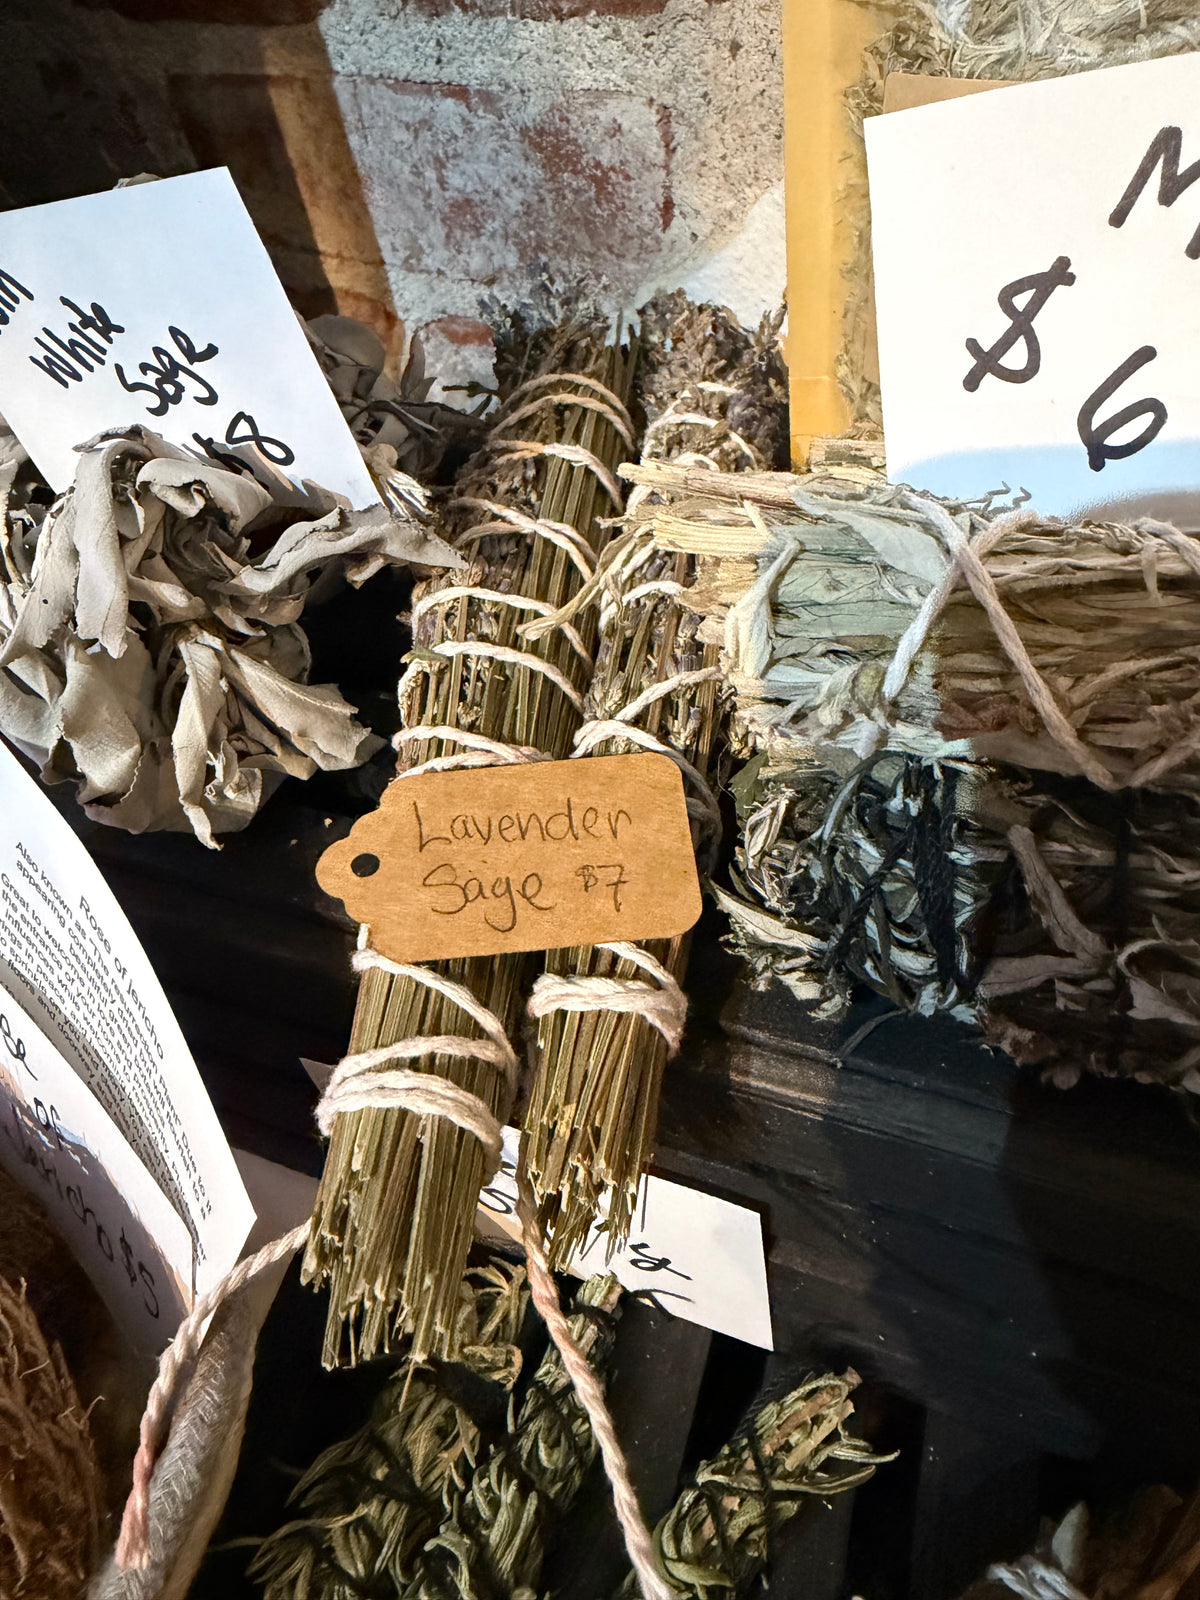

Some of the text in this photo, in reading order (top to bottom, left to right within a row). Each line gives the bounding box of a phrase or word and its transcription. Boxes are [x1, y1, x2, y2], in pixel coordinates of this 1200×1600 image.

[29, 296, 125, 389] White
[115, 326, 218, 416] Sage
[413, 797, 632, 853] Lavender
[80, 895, 111, 954] Rose
[114, 957, 127, 979] of
[422, 863, 629, 932] Sage $7
[1, 873, 29, 912] Great
[30, 909, 41, 925] to
[43, 926, 85, 986] welcome
[86, 987, 94, 1003] in
[96, 1002, 114, 1037] love
[116, 1039, 132, 1070] and
[3, 889, 17, 913] the
[19, 913, 62, 969] entrance
[64, 971, 75, 985] of
[75, 986, 96, 1017] your
[97, 1019, 120, 1063] home
[122, 1065, 130, 1082] to
[4, 909, 54, 974] influences
[58, 974, 79, 1010] while
[82, 1012, 125, 1092] welcoming
[10, 947, 47, 995] sprinkle
[64, 1015, 80, 1042] you
[82, 1043, 99, 1070] and
[15, 841, 38, 872] Also
[40, 870, 72, 919] known
[73, 919, 86, 939] as
[110, 977, 157, 1074] resurrection
[181, 1131, 196, 1173] Due
[197, 1175, 205, 1196] to
[25, 948, 34, 964] in
[70, 1010, 87, 1038] and
[68, 943, 107, 1007] beautiful
[108, 1009, 131, 1054] green
[15, 860, 66, 927] appearing
[67, 927, 116, 1003] completely
[117, 1007, 138, 1048] dried
[139, 1048, 151, 1078] but
[153, 1079, 165, 1108] will
[165, 1110, 191, 1178] flourish
[192, 1180, 199, 1201] to
[38, 996, 56, 1022] and
[58, 1020, 95, 1078] doorway
